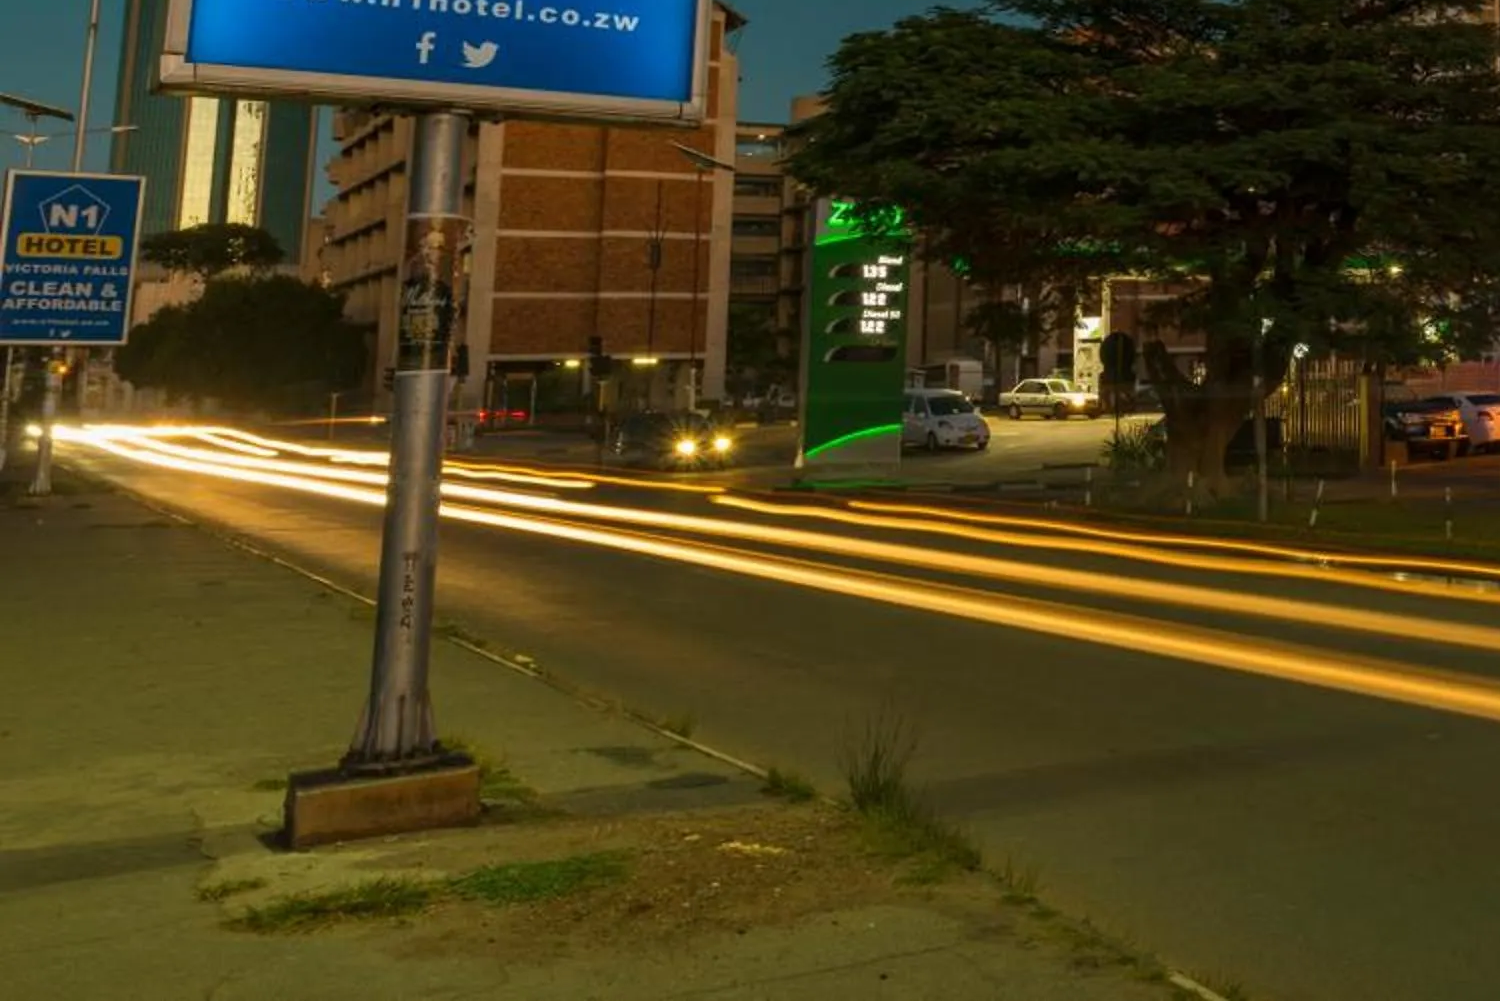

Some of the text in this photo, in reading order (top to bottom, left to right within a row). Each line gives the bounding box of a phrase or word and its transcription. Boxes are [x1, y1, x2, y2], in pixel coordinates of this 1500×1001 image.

[51, 204, 98, 228] N1
[26, 236, 112, 255] HOTEL
[6, 263, 128, 276] VICTORIA FALLS
[10, 281, 117, 297] CLEAN &
[3, 298, 122, 311] AFFORDABLE
